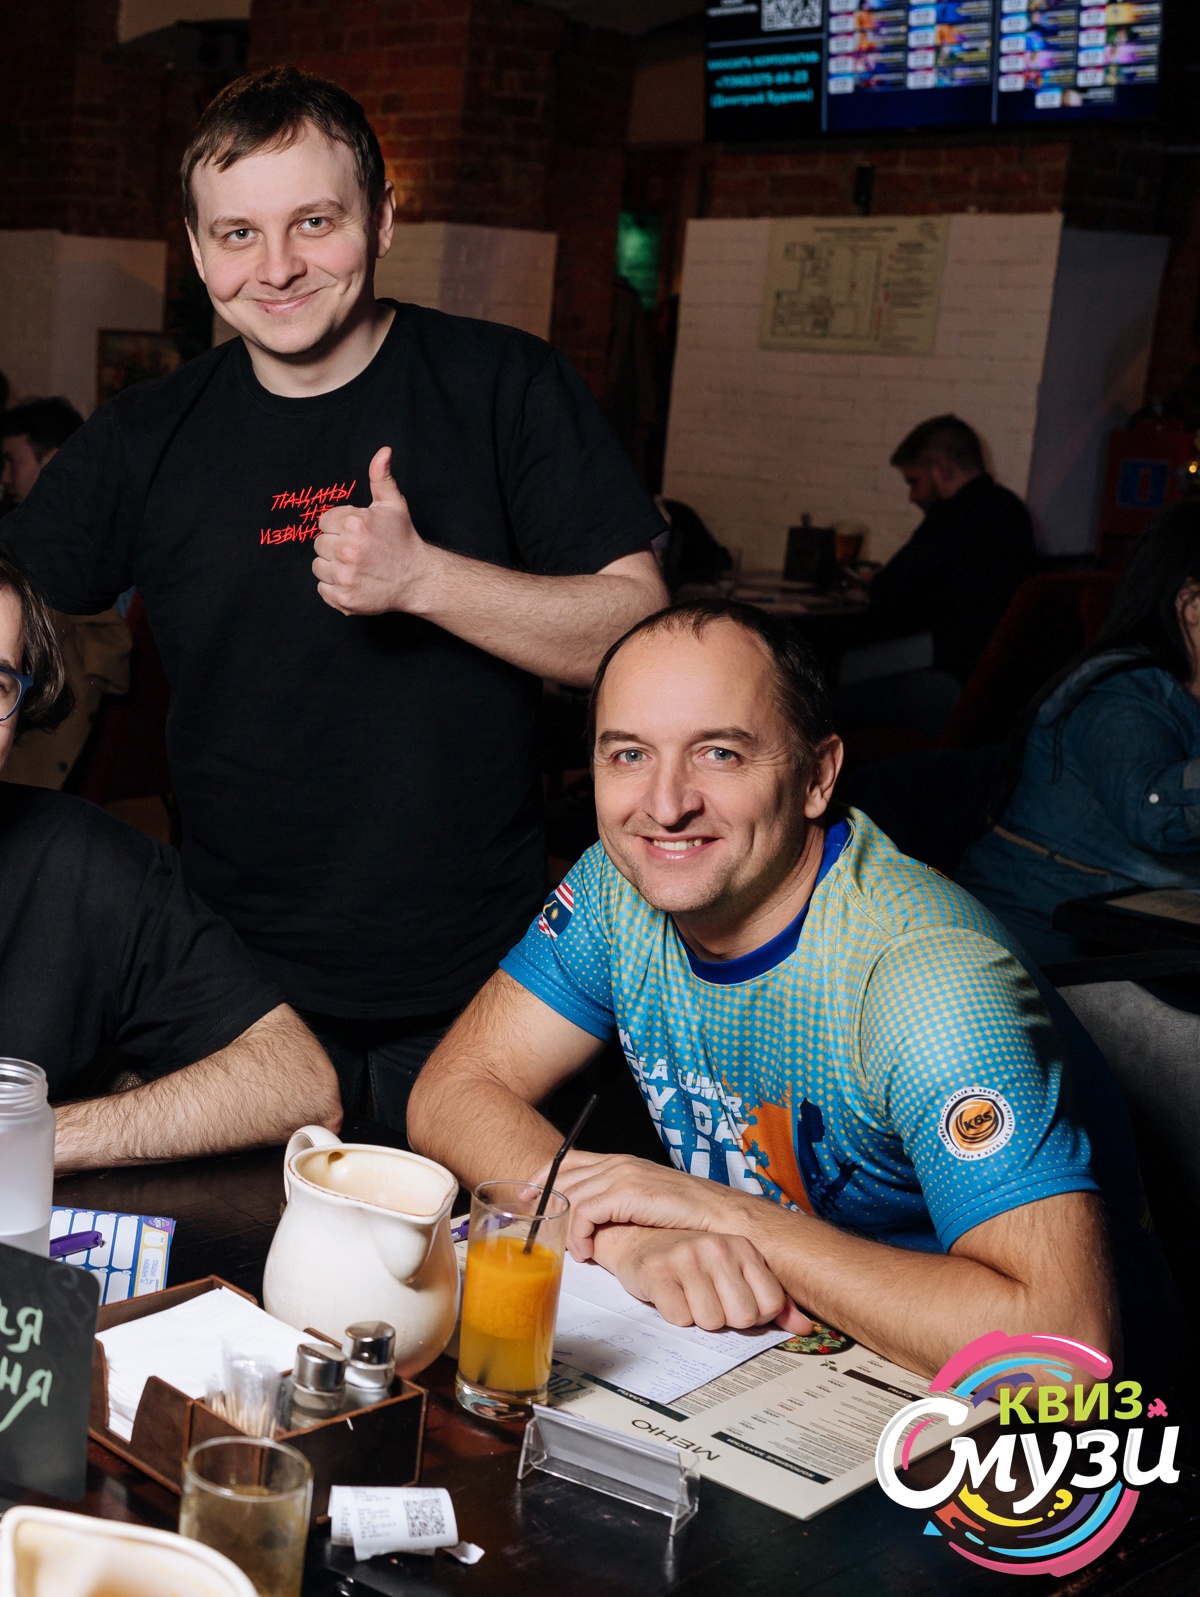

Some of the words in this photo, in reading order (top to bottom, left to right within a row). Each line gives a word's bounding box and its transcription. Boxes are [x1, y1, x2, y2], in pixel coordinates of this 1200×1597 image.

[271, 480, 357, 511] ПАЦАНЫ
[259, 521, 324, 545] ИЗВИН
[963, 1110, 993, 1132] KBS
[617, 1388, 650, 1405] САЛАТЫ
[631, 1419, 721, 1461] МЕНЮ
